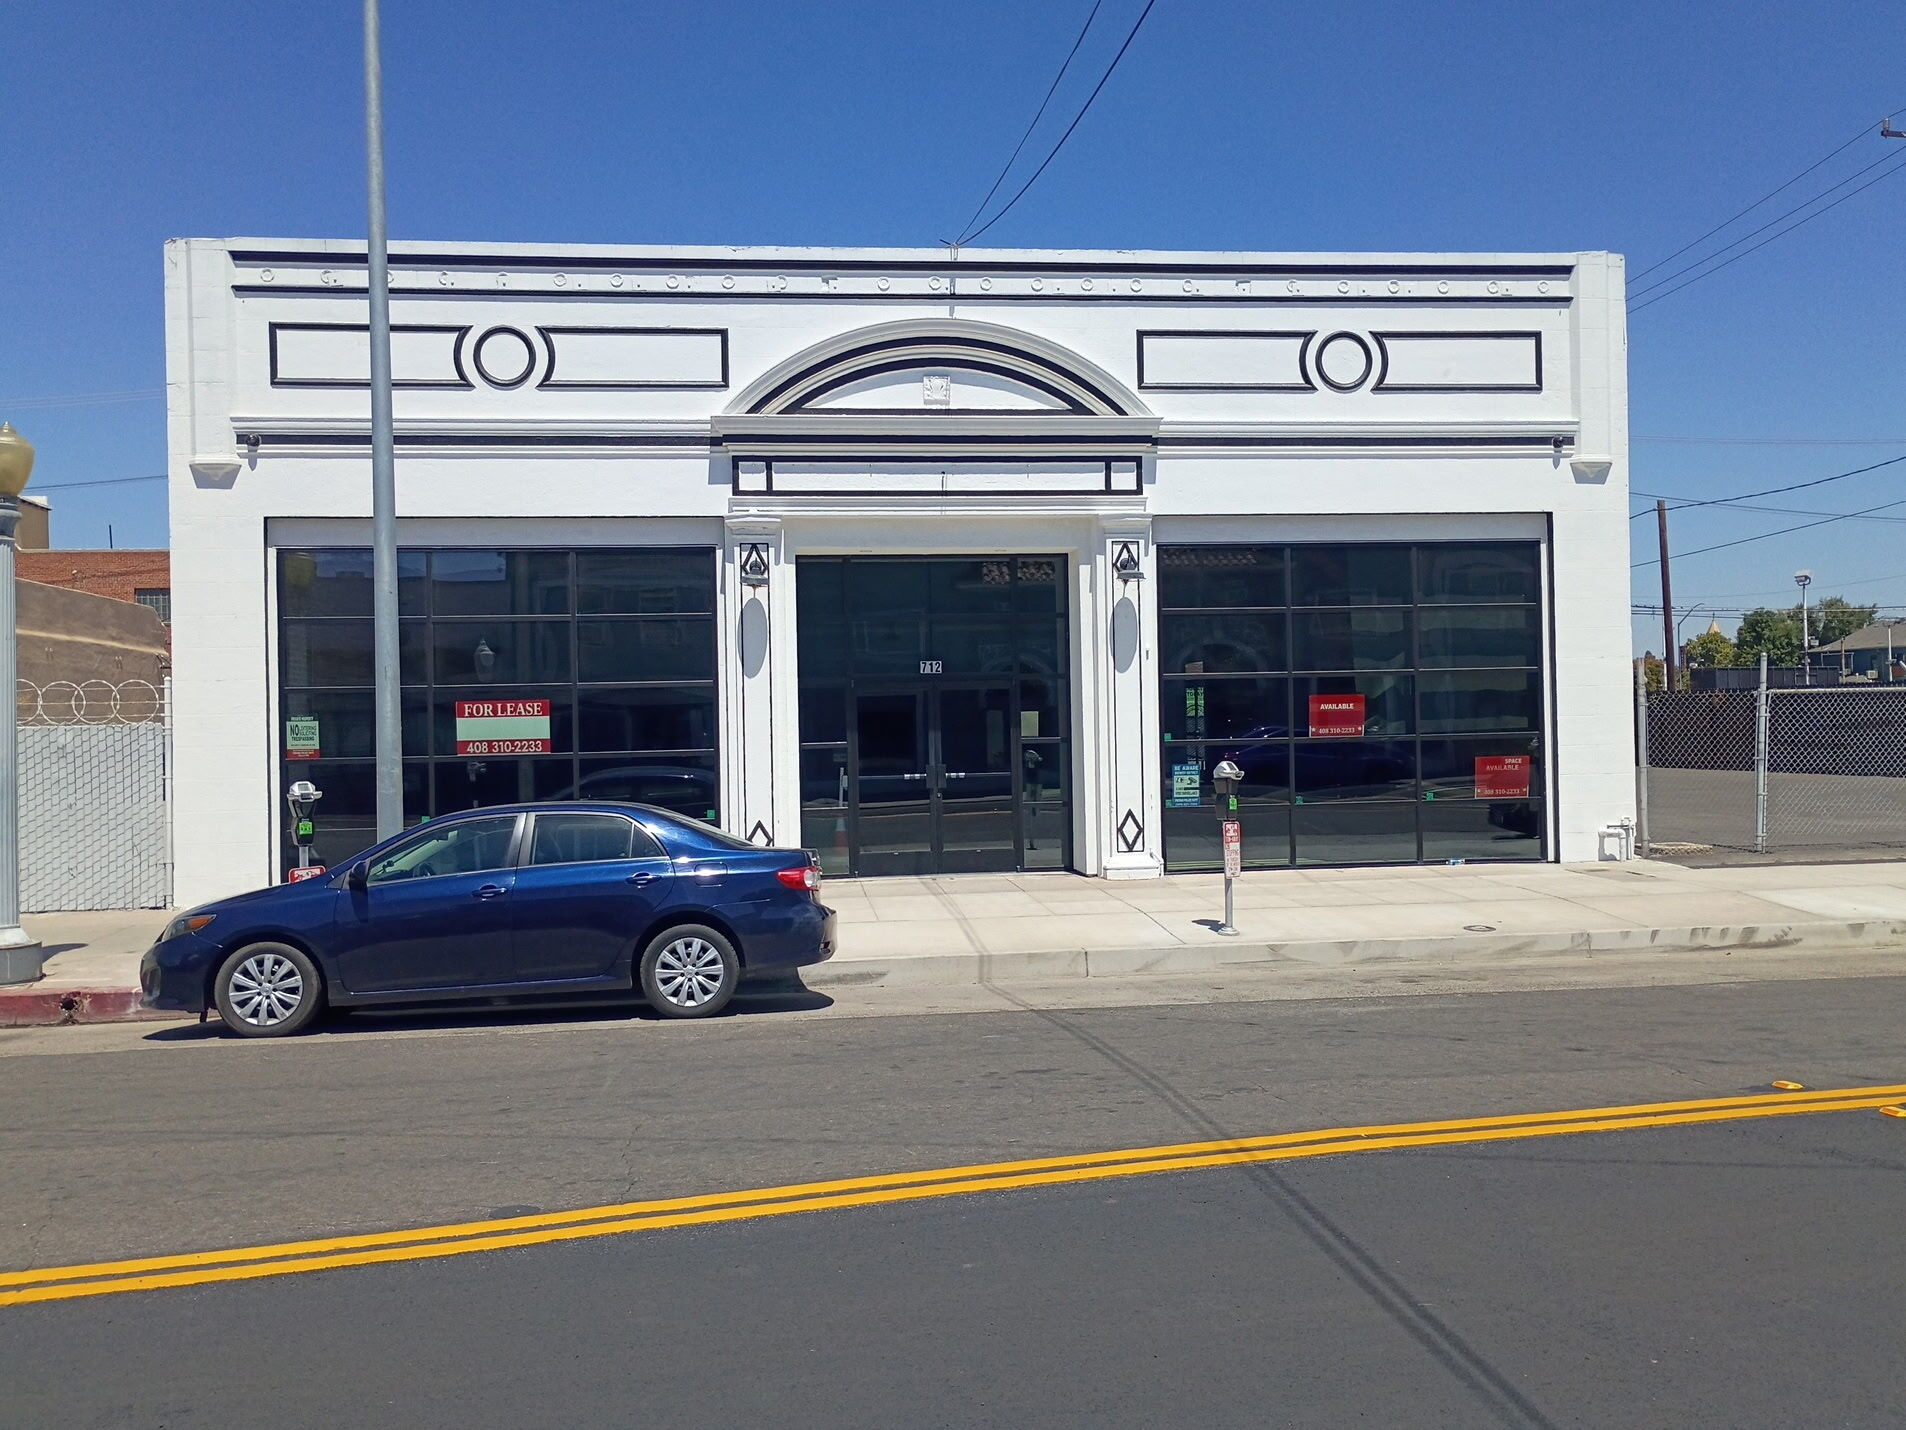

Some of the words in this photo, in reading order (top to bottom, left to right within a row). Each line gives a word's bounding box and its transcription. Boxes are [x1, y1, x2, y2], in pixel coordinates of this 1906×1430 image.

[921, 661, 941, 673] 712
[464, 703, 494, 717] FOR
[497, 702, 543, 716] LEASE
[290, 724, 300, 736] NO
[467, 742, 489, 753] 408
[492, 740, 542, 753] 310-2233
